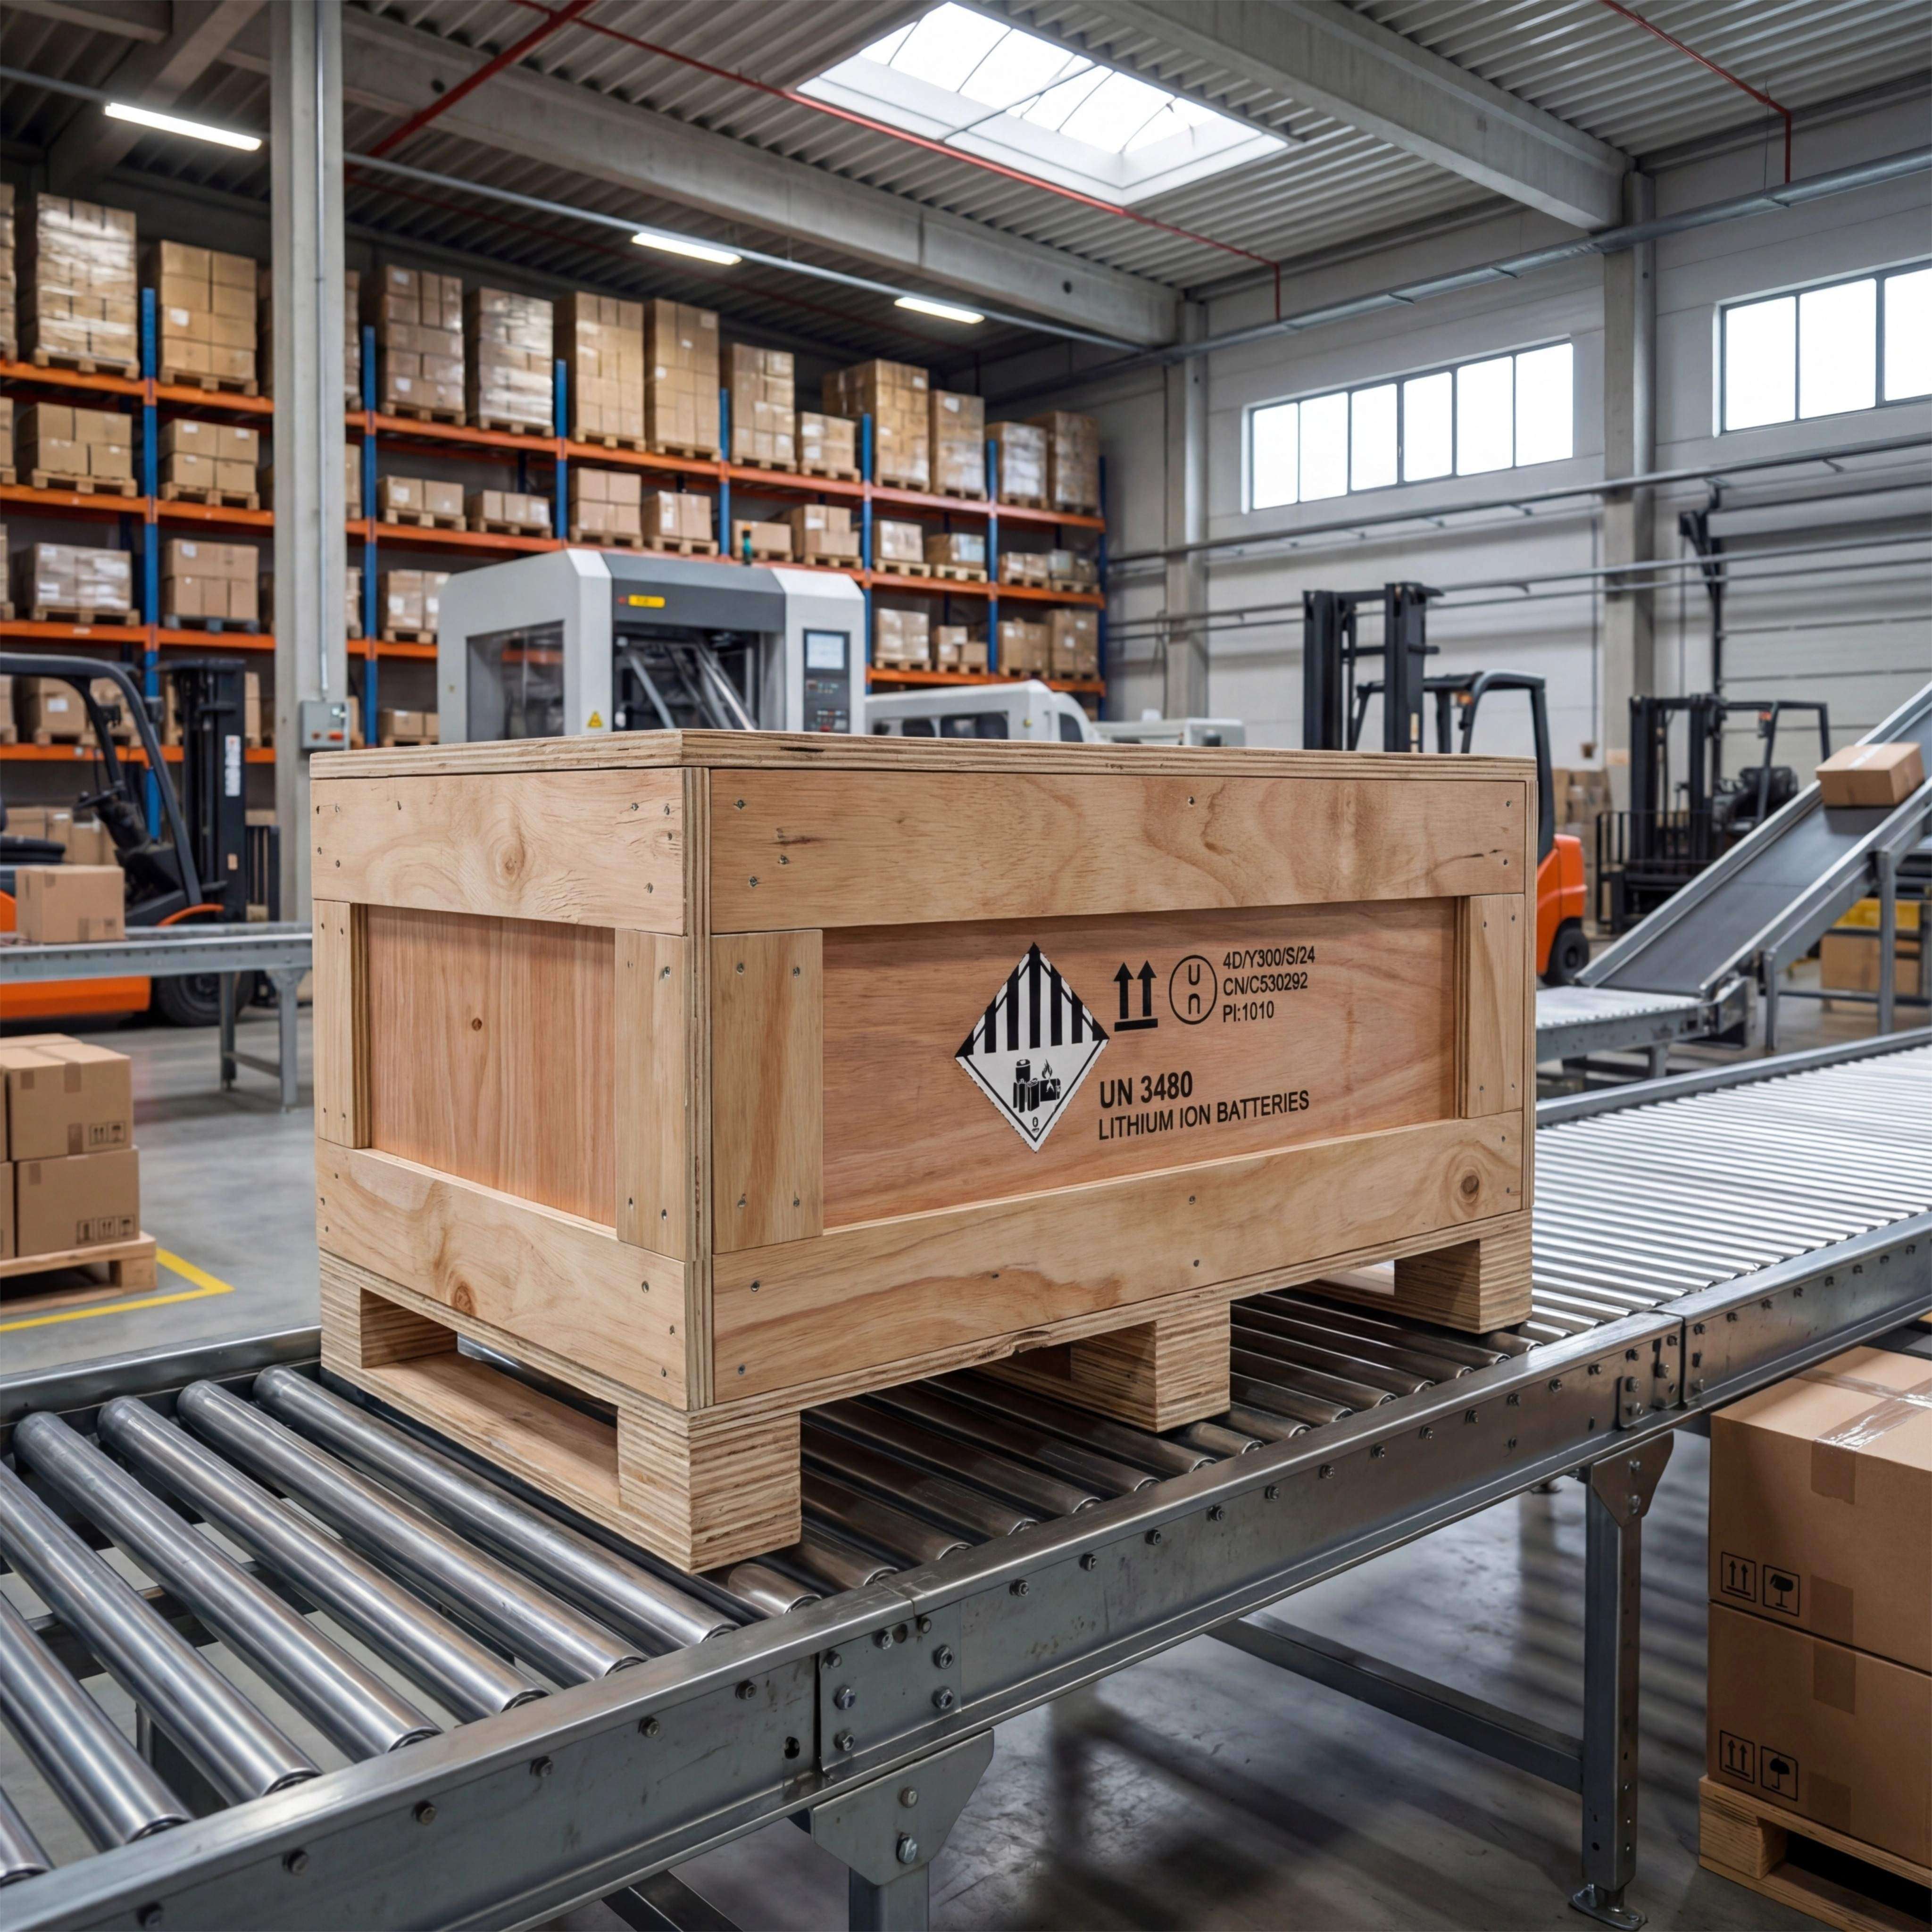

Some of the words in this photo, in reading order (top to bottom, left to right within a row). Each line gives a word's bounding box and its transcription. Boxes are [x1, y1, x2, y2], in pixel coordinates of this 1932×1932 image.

[1223, 946, 1315, 969] 4D/Y300/S/24
[1223, 972, 1308, 996] CN/C530292
[1223, 1000, 1274, 1023] PI:1010
[1100, 1077, 1133, 1108] UN
[1141, 1070, 1193, 1103] 3480
[1099, 1109, 1173, 1141] LITHIUM
[1180, 1104, 1210, 1129] ION
[1217, 1090, 1309, 1123] BATTERIES
